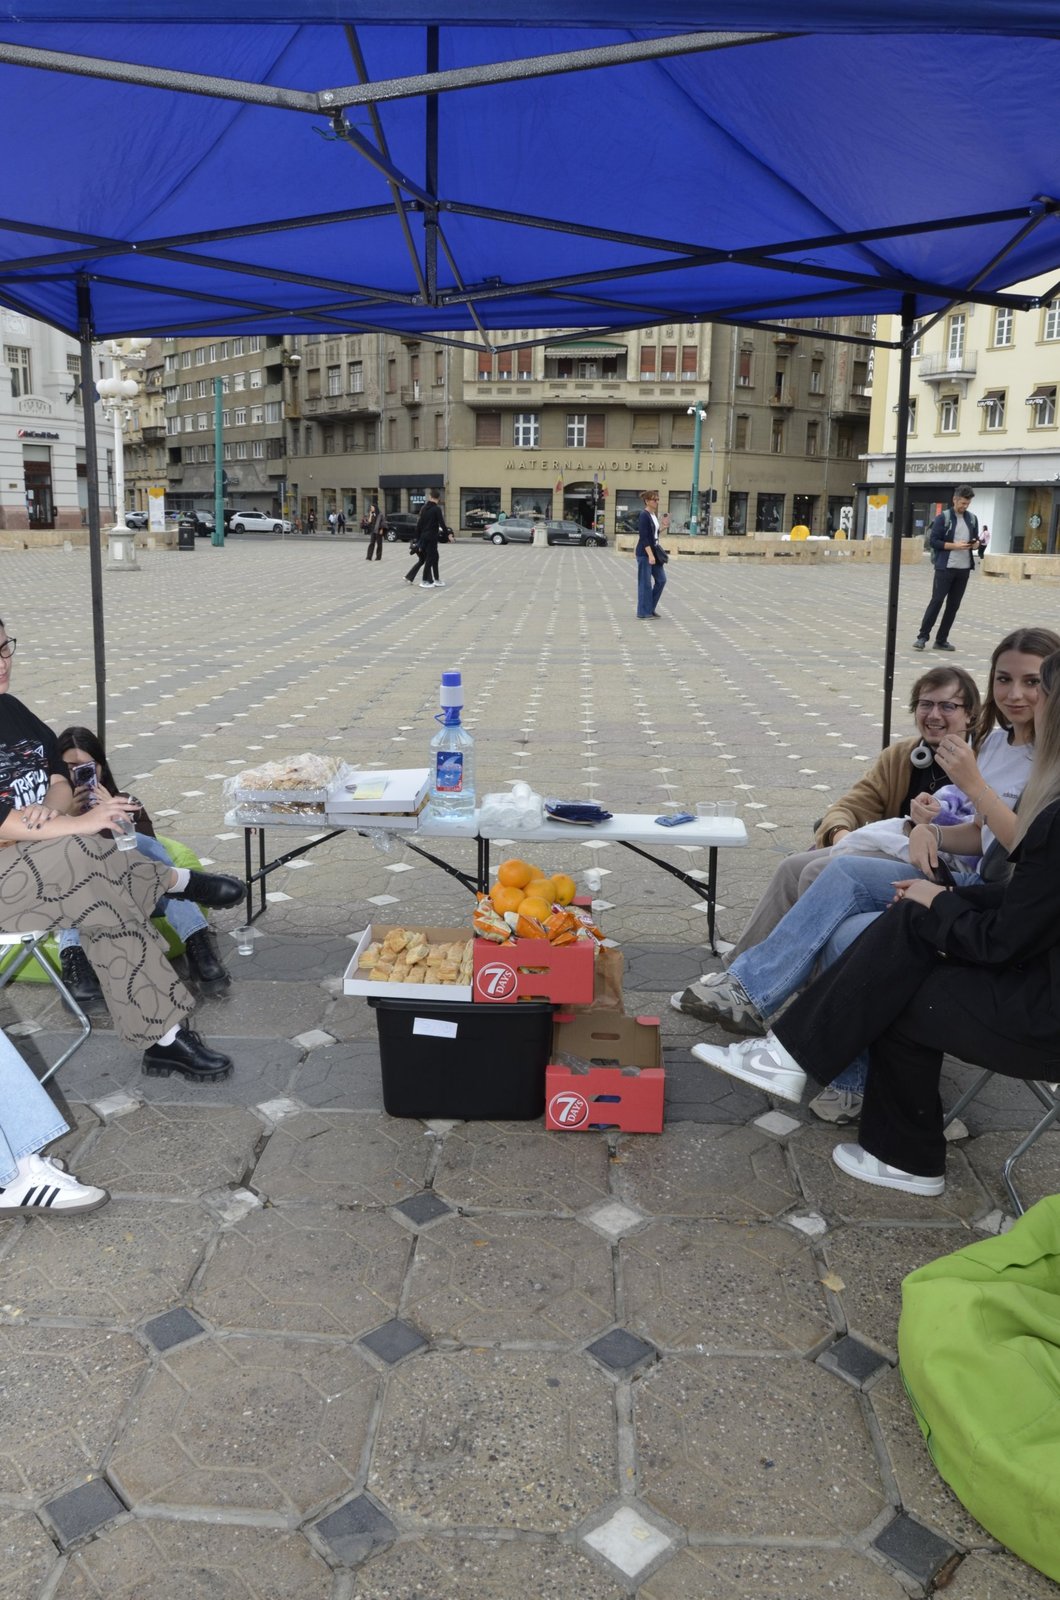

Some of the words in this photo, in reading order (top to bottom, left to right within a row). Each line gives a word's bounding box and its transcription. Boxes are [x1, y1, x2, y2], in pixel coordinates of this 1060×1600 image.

[484, 968, 506, 995] 7
[495, 970, 513, 994] DAYS
[556, 1097, 577, 1123] 7
[567, 1099, 584, 1122] DAYS
